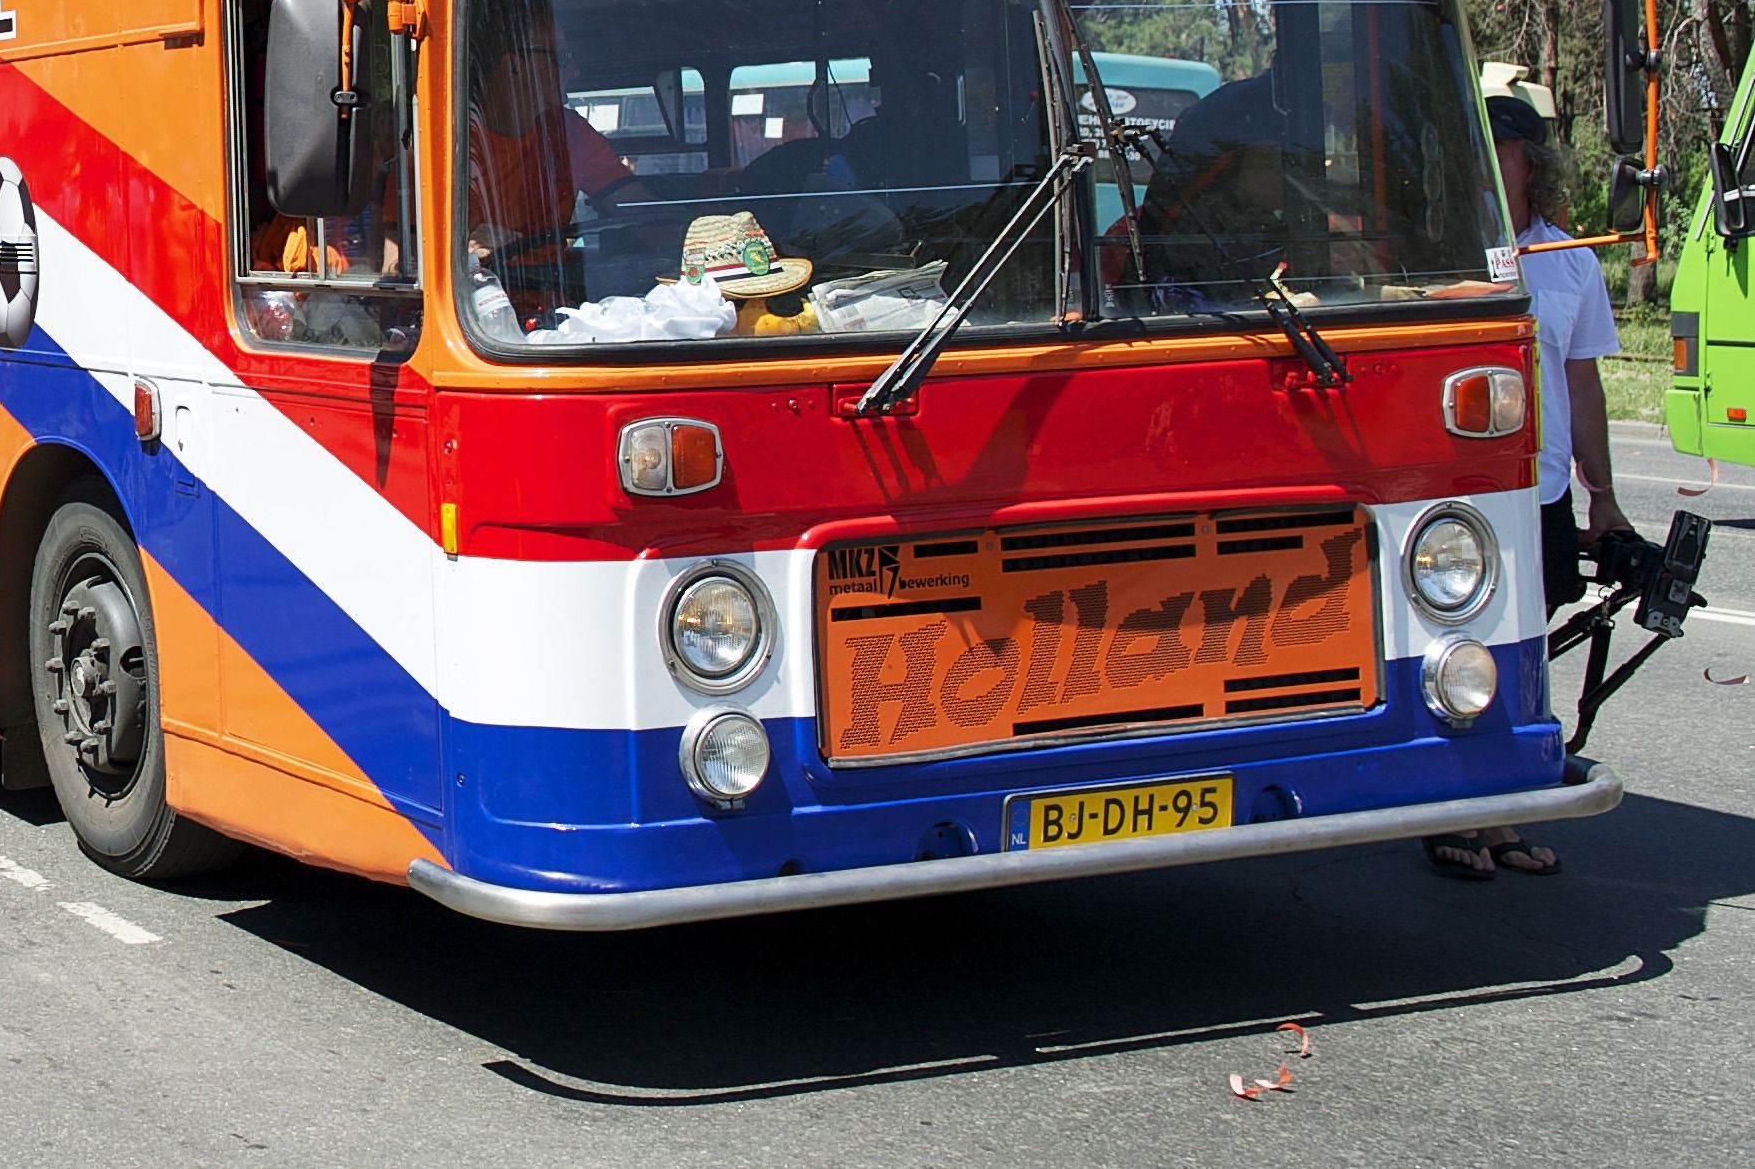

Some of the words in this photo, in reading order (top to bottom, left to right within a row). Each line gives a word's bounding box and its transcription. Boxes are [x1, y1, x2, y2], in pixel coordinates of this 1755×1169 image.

[827, 548, 877, 581] MKZ
[829, 579, 877, 596] metaal
[898, 574, 970, 590] bewerking
[839, 528, 1363, 750] Holland
[1042, 786, 1219, 844] BJ-DH-95
[1010, 832, 1027, 846] NL
